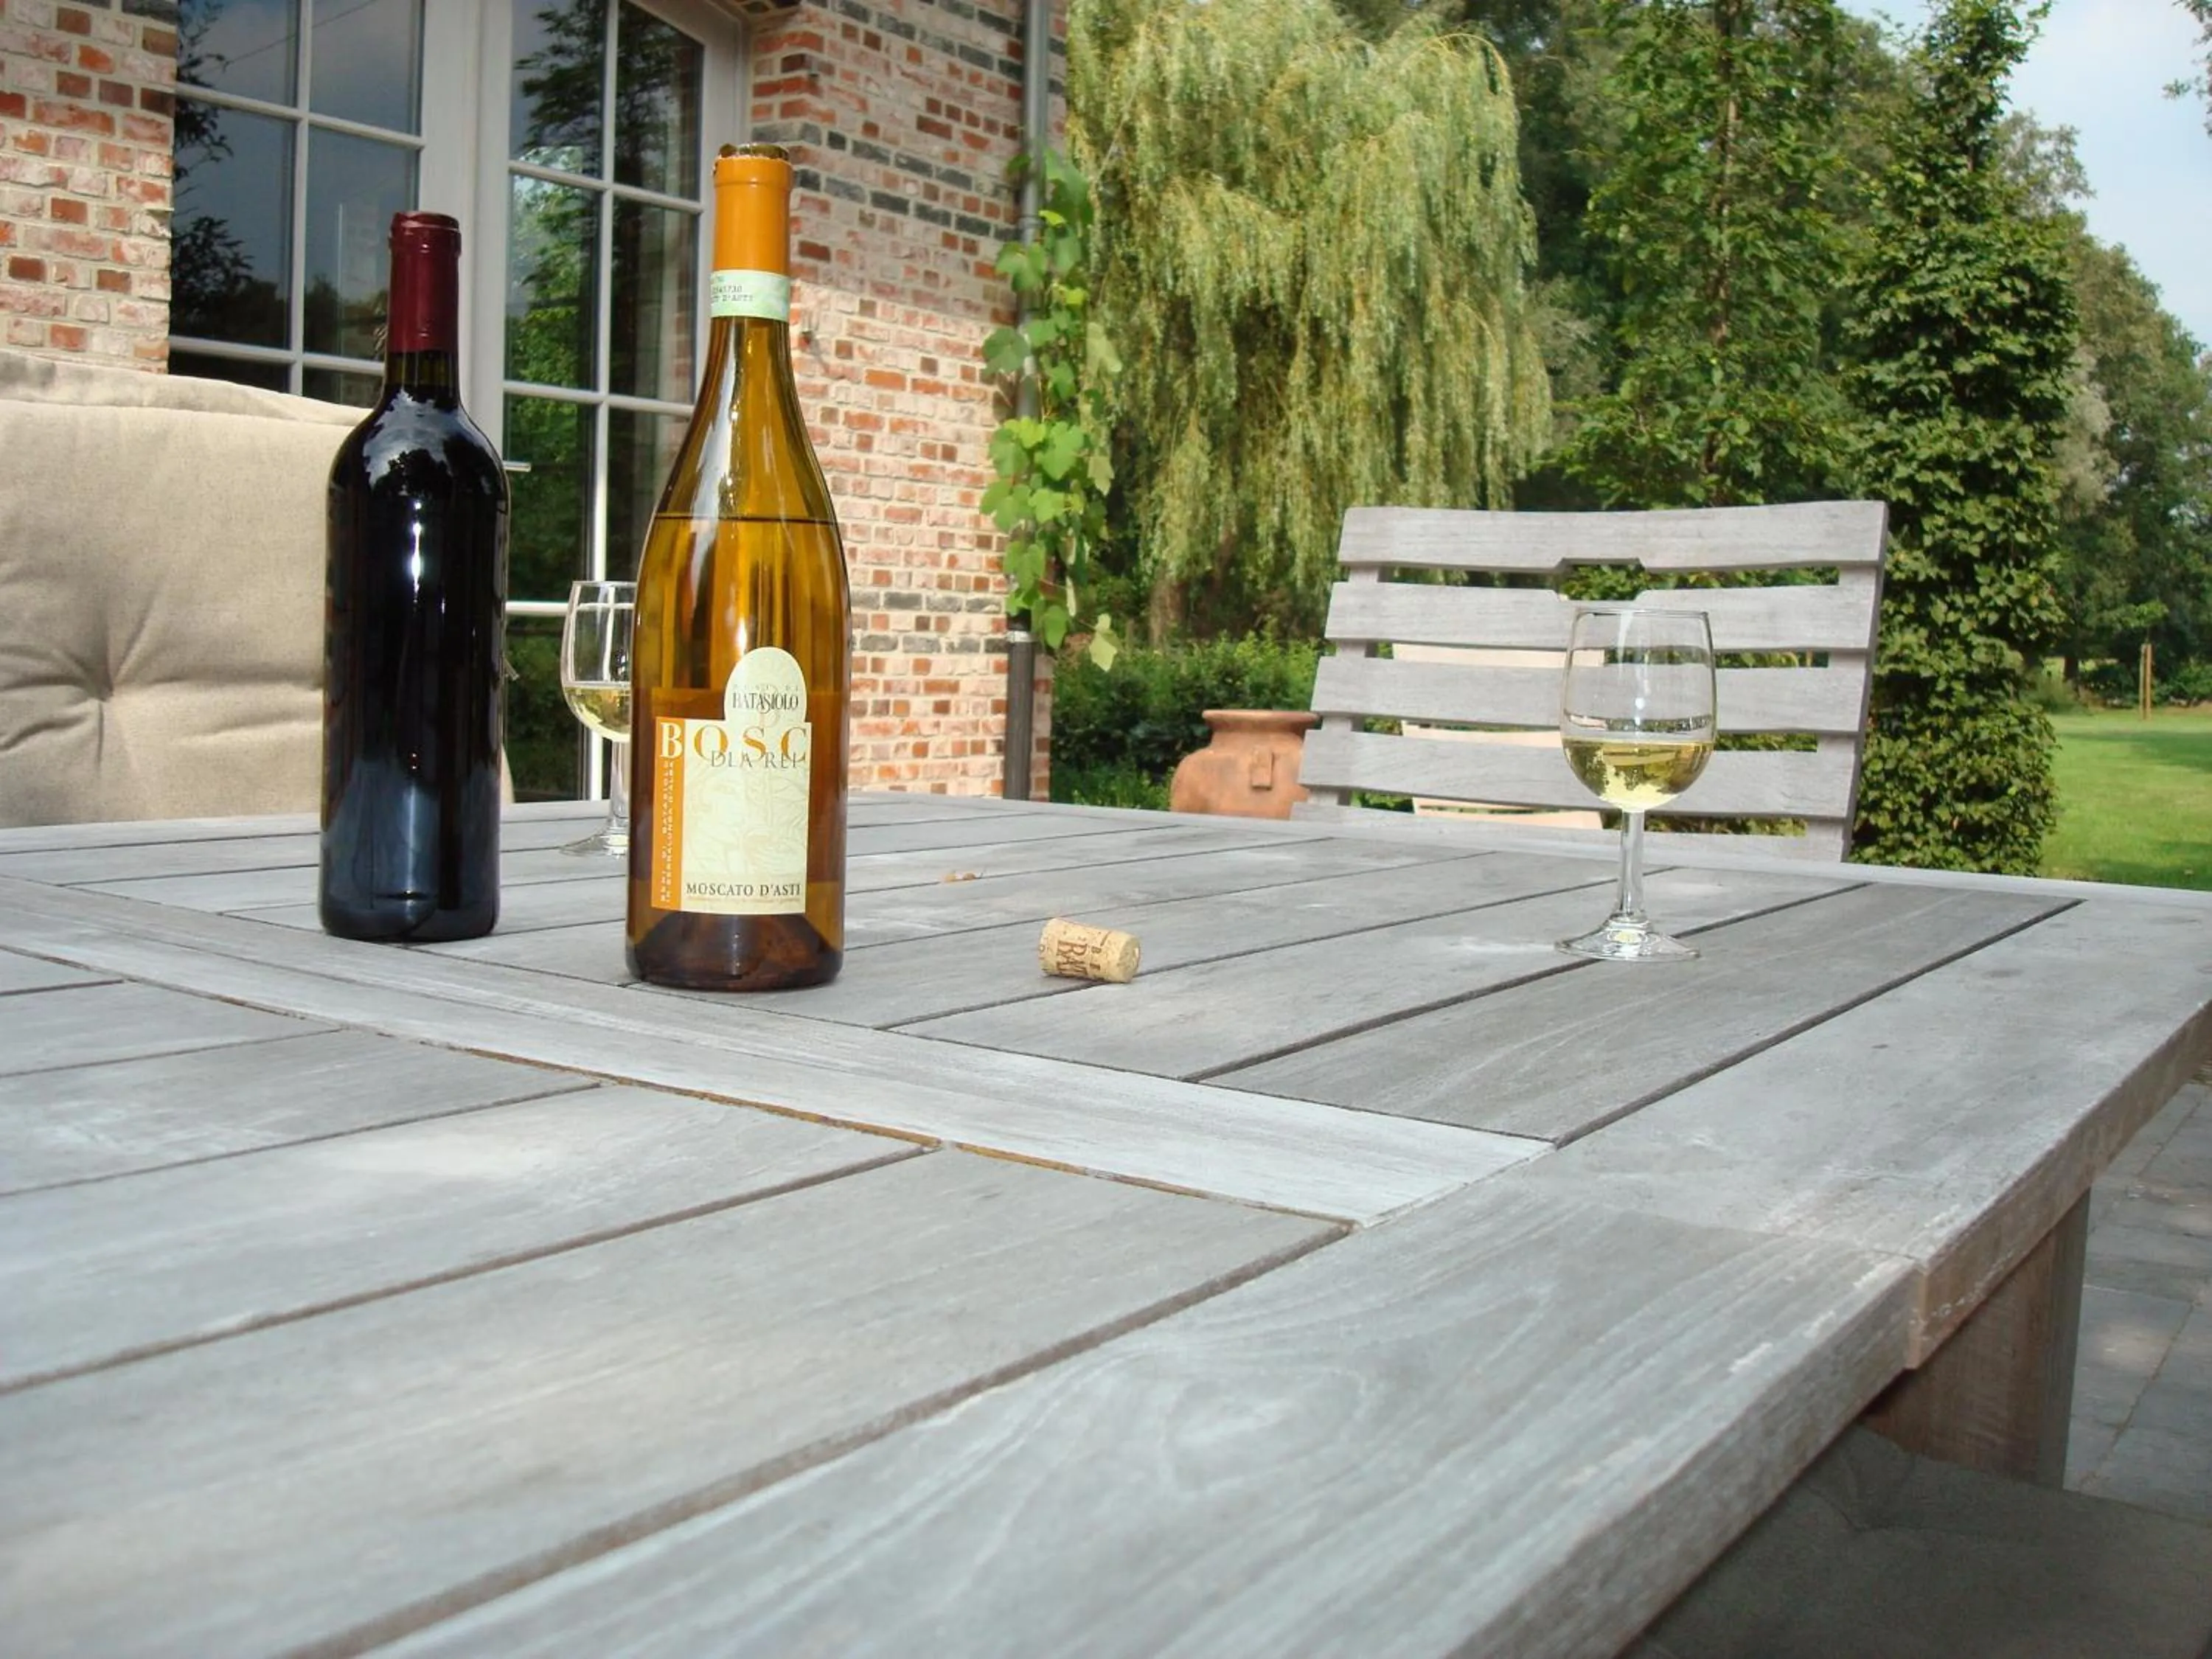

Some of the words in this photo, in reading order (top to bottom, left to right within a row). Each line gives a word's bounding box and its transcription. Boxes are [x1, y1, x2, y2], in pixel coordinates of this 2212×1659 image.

[732, 692, 799, 714] BATASIOLO
[661, 722, 807, 762] BOSC
[686, 883, 754, 896] MOSCATO
[760, 883, 801, 897] D'ASTI
